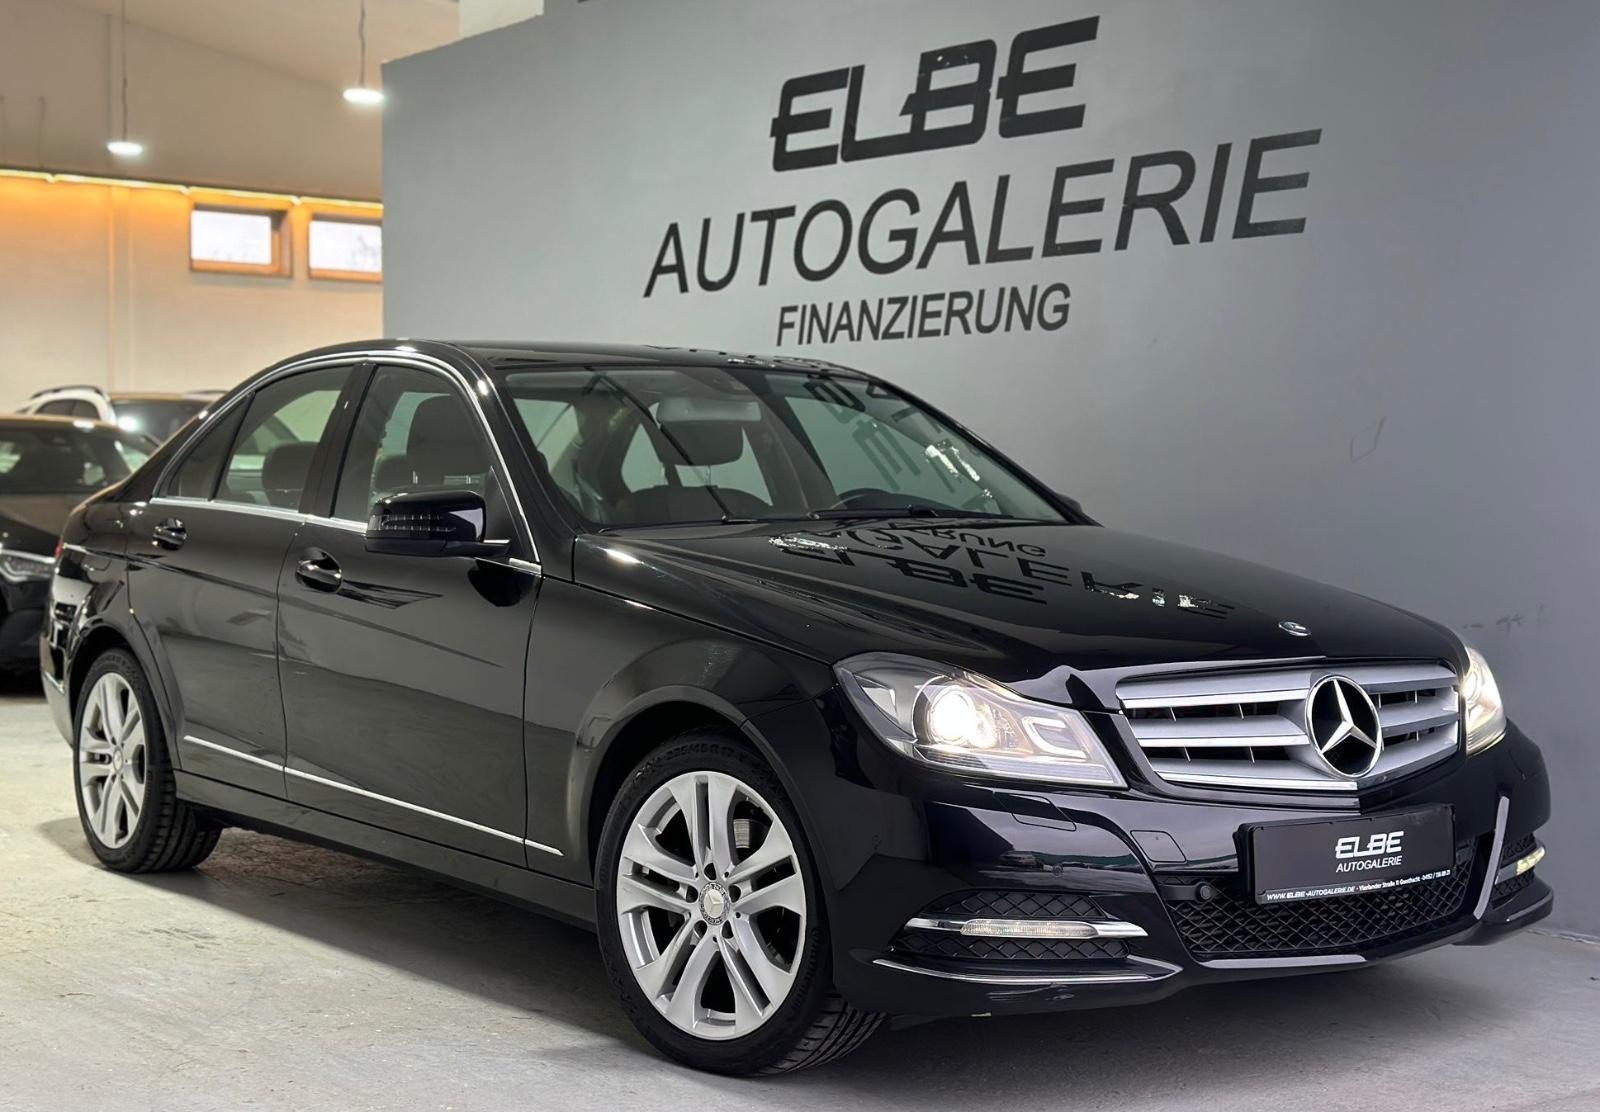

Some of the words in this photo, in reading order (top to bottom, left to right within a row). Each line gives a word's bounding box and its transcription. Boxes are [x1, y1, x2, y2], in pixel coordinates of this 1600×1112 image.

[770, 16, 1100, 172] ELBE
[642, 128, 1322, 298] AUTOGALERIE
[776, 282, 1071, 346] FINANZIERUNG
[1335, 831, 1404, 859] ELBE
[1335, 855, 1403, 873] AUTOGALERIE
